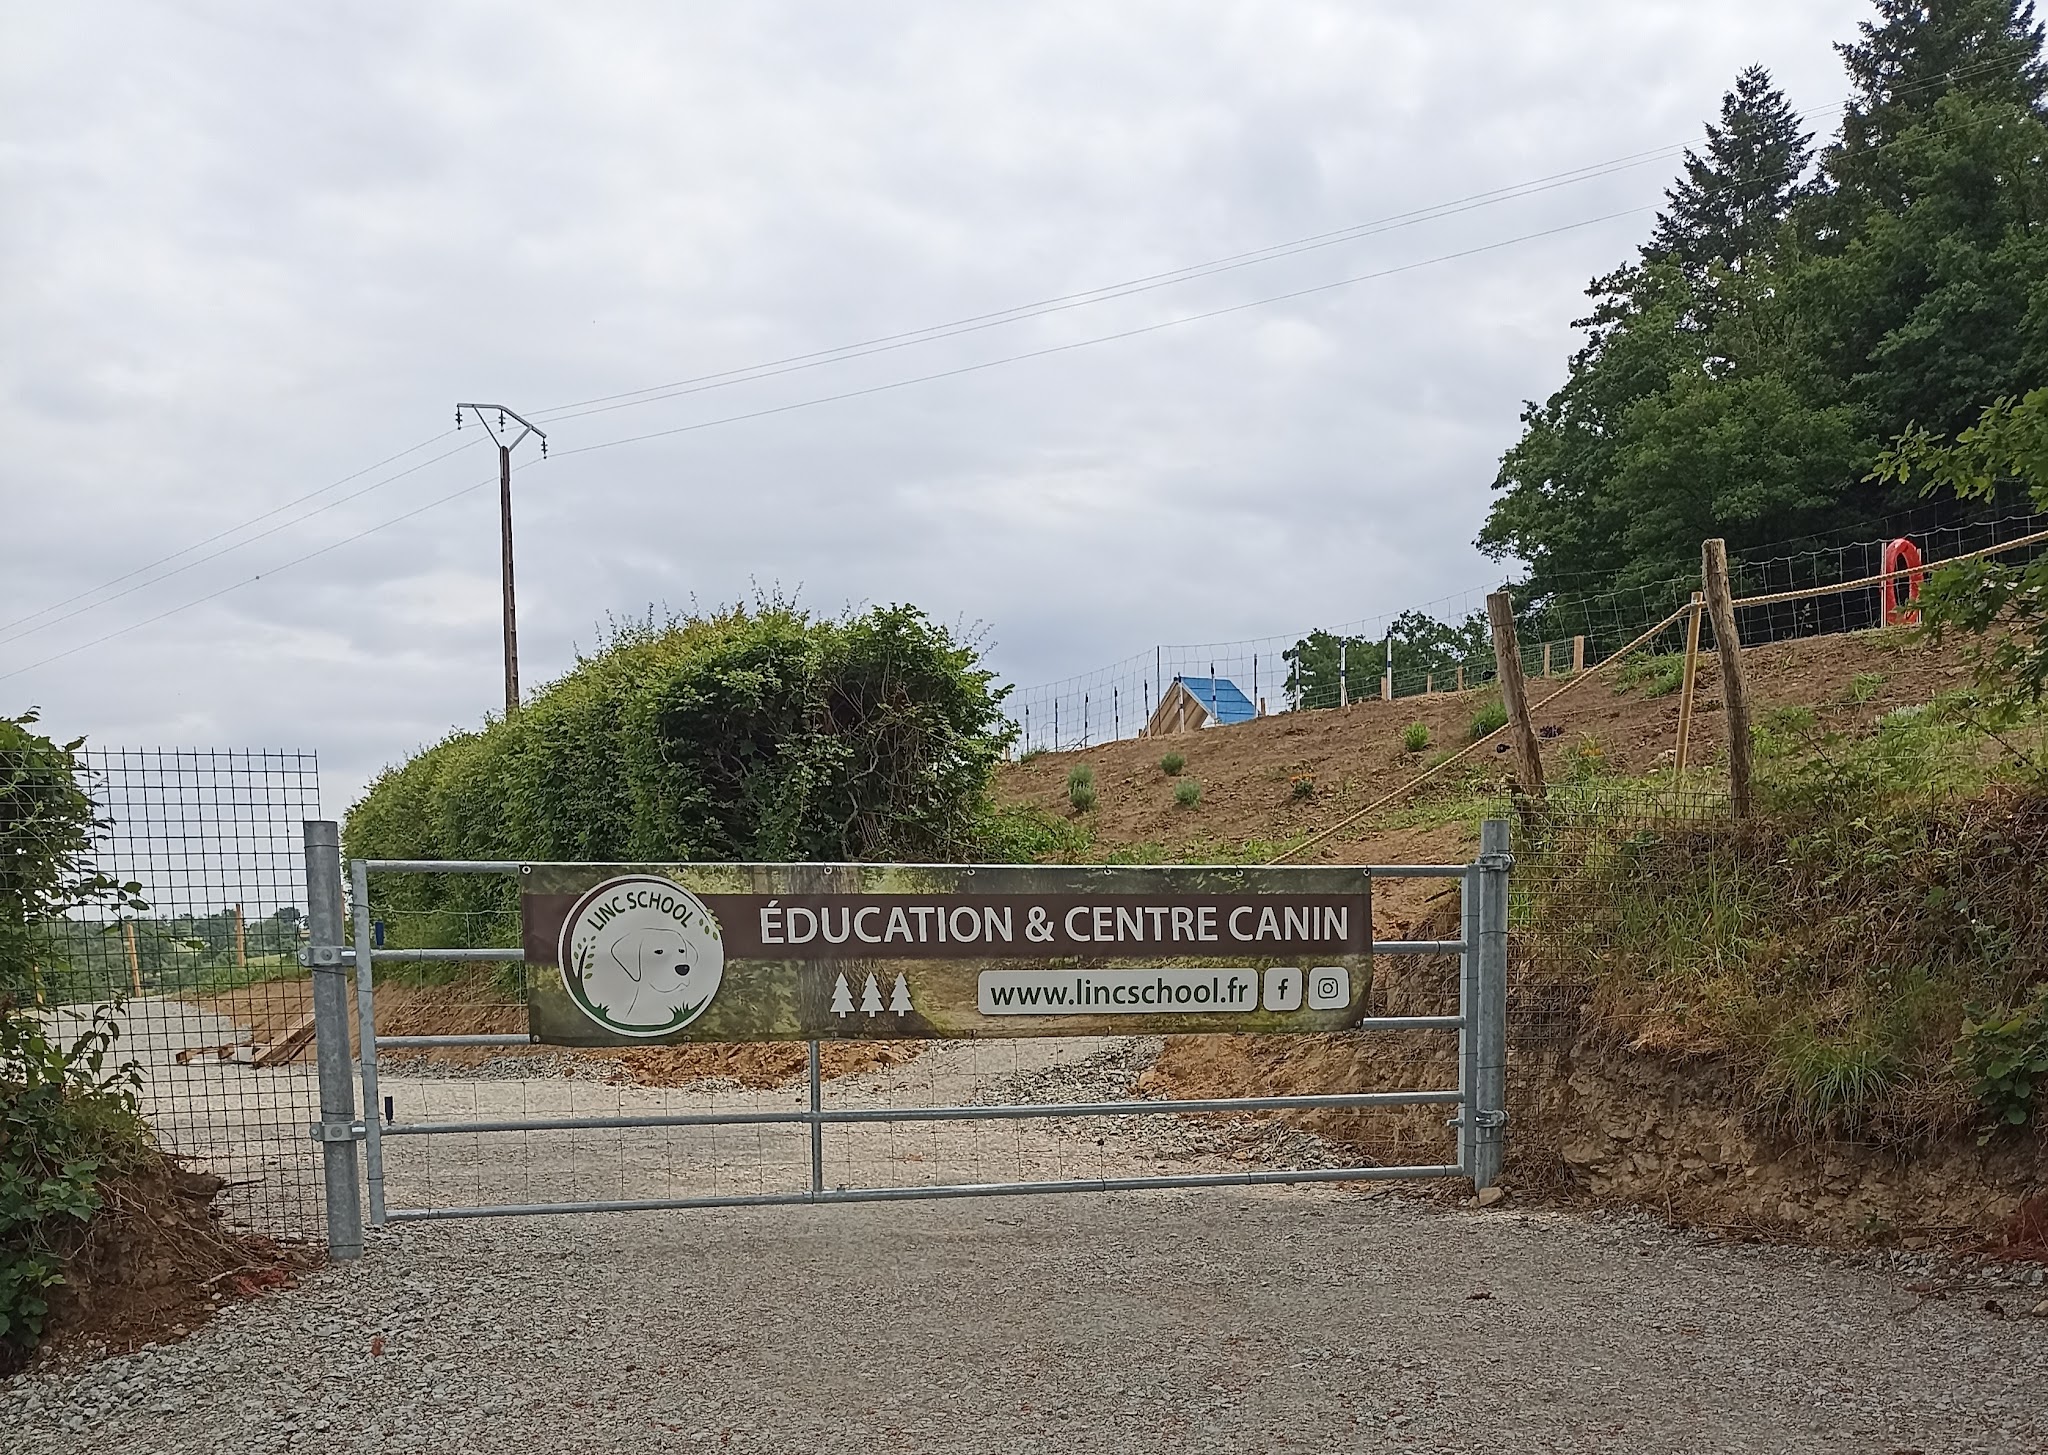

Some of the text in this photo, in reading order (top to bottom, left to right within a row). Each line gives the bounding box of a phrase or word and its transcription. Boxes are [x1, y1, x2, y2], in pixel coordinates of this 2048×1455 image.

[587, 890, 694, 931] LINC SCHOOL
[759, 899, 1349, 945] ÉDUCATION & CENTRE CANIN
[990, 976, 1249, 1007] www.lincschool.fr
